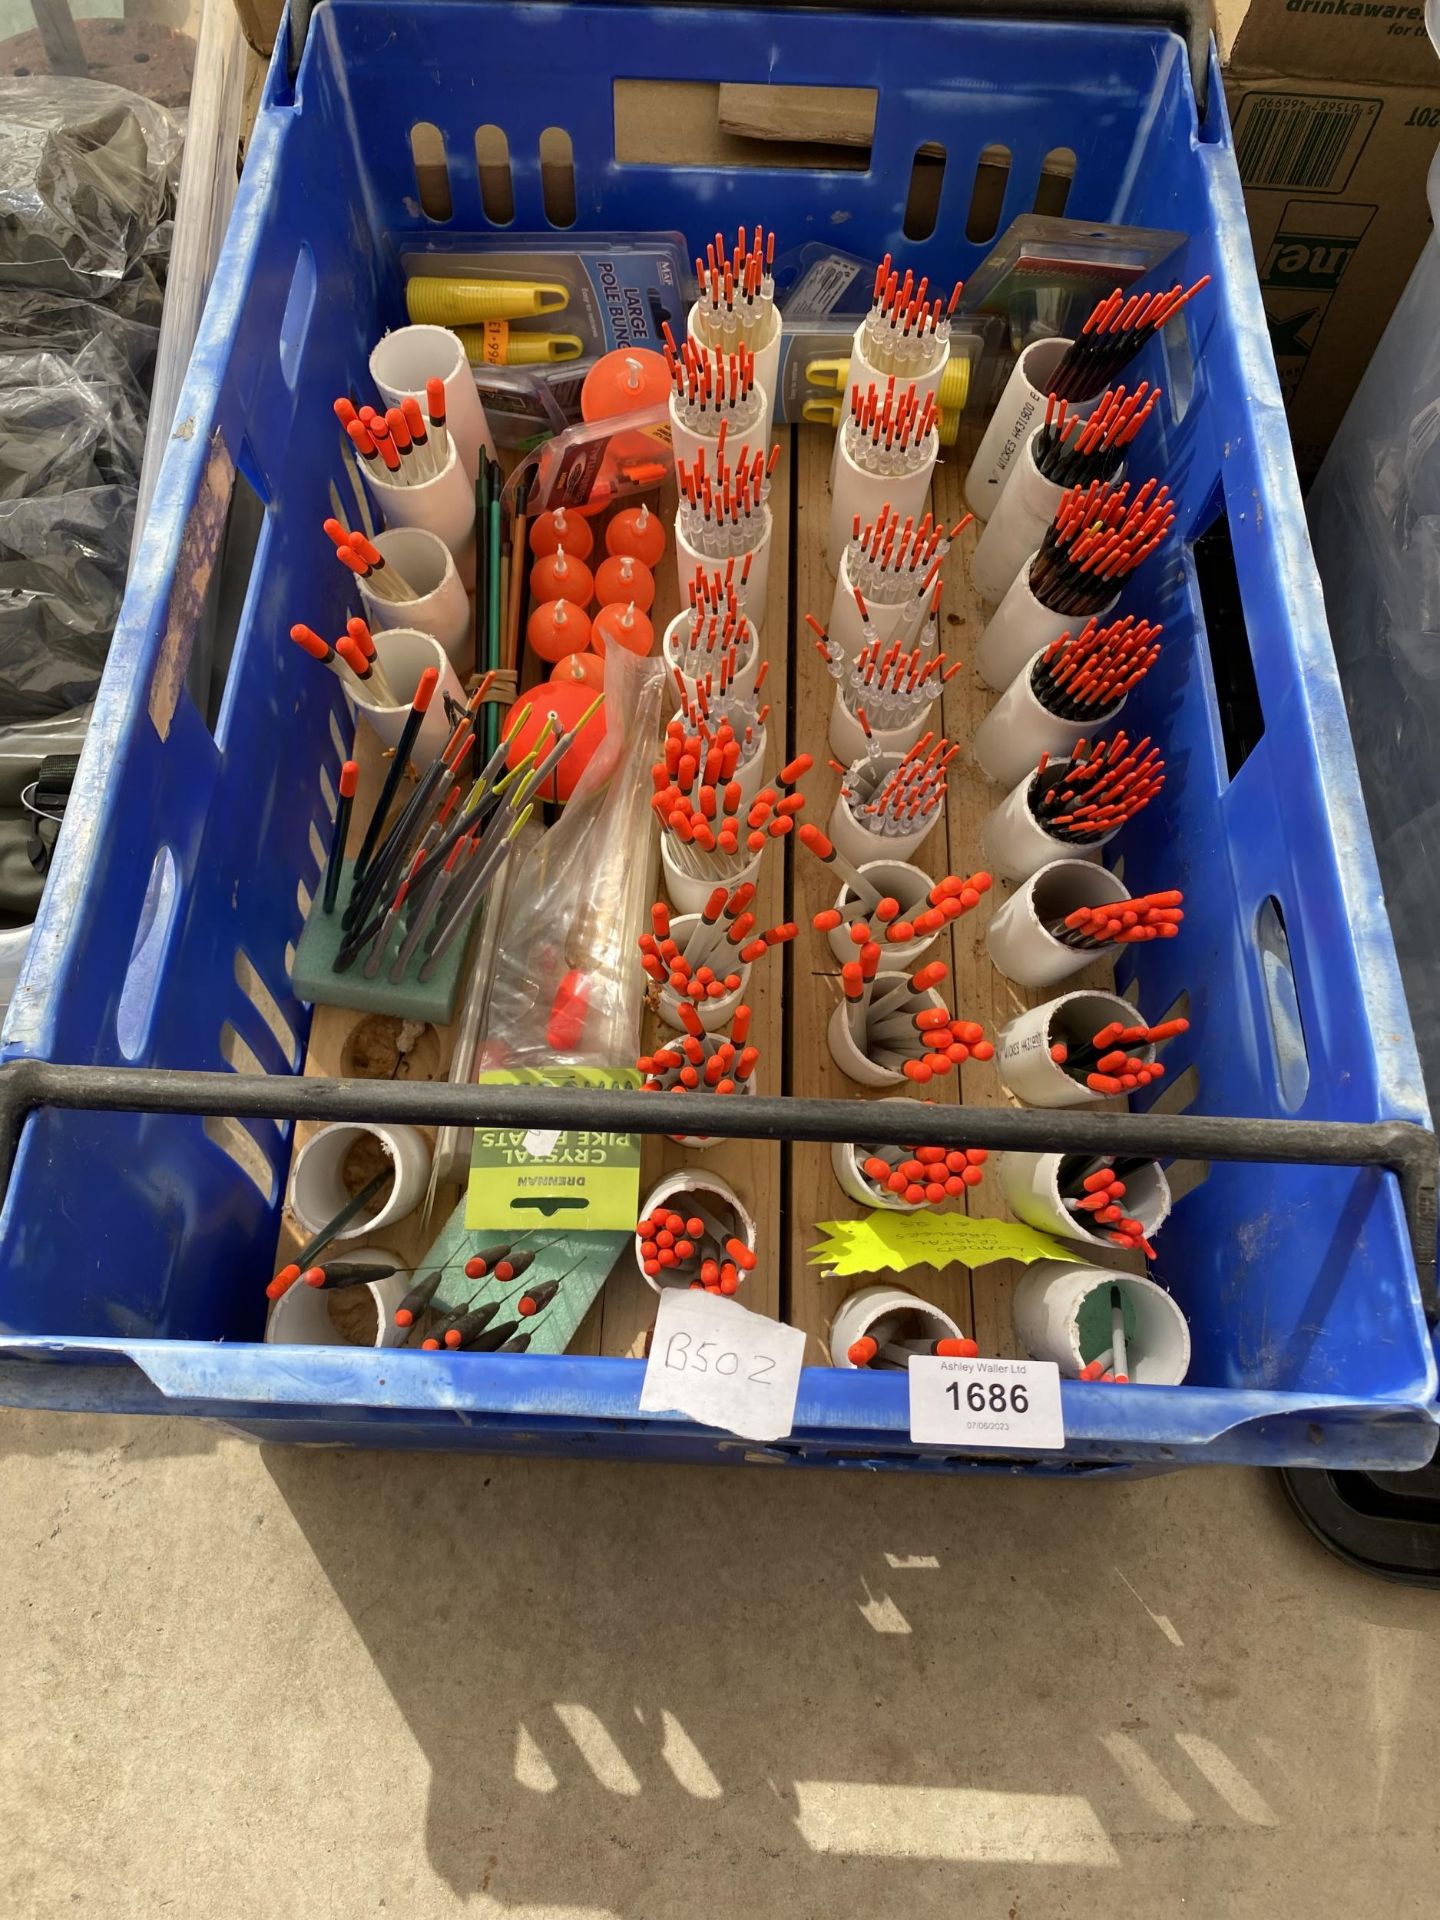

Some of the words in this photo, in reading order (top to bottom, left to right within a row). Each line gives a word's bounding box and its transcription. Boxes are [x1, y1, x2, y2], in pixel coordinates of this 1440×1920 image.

[1387, 23, 1412, 36] for
[596, 261, 621, 303] POLE
[623, 287, 649, 339] LARGE
[996, 439, 1017, 470] WICKES
[1011, 401, 1035, 439] H431900
[481, 1130, 569, 1147] FATS
[578, 1131, 631, 1147] PIKE
[517, 1176, 586, 1187] DRENNAN
[665, 1331, 777, 1385] B502
[940, 1361, 975, 1374] Ashley
[977, 1363, 1009, 1373] Waller
[1010, 1364, 1027, 1374] Ltd
[945, 1381, 1029, 1413] 1686
